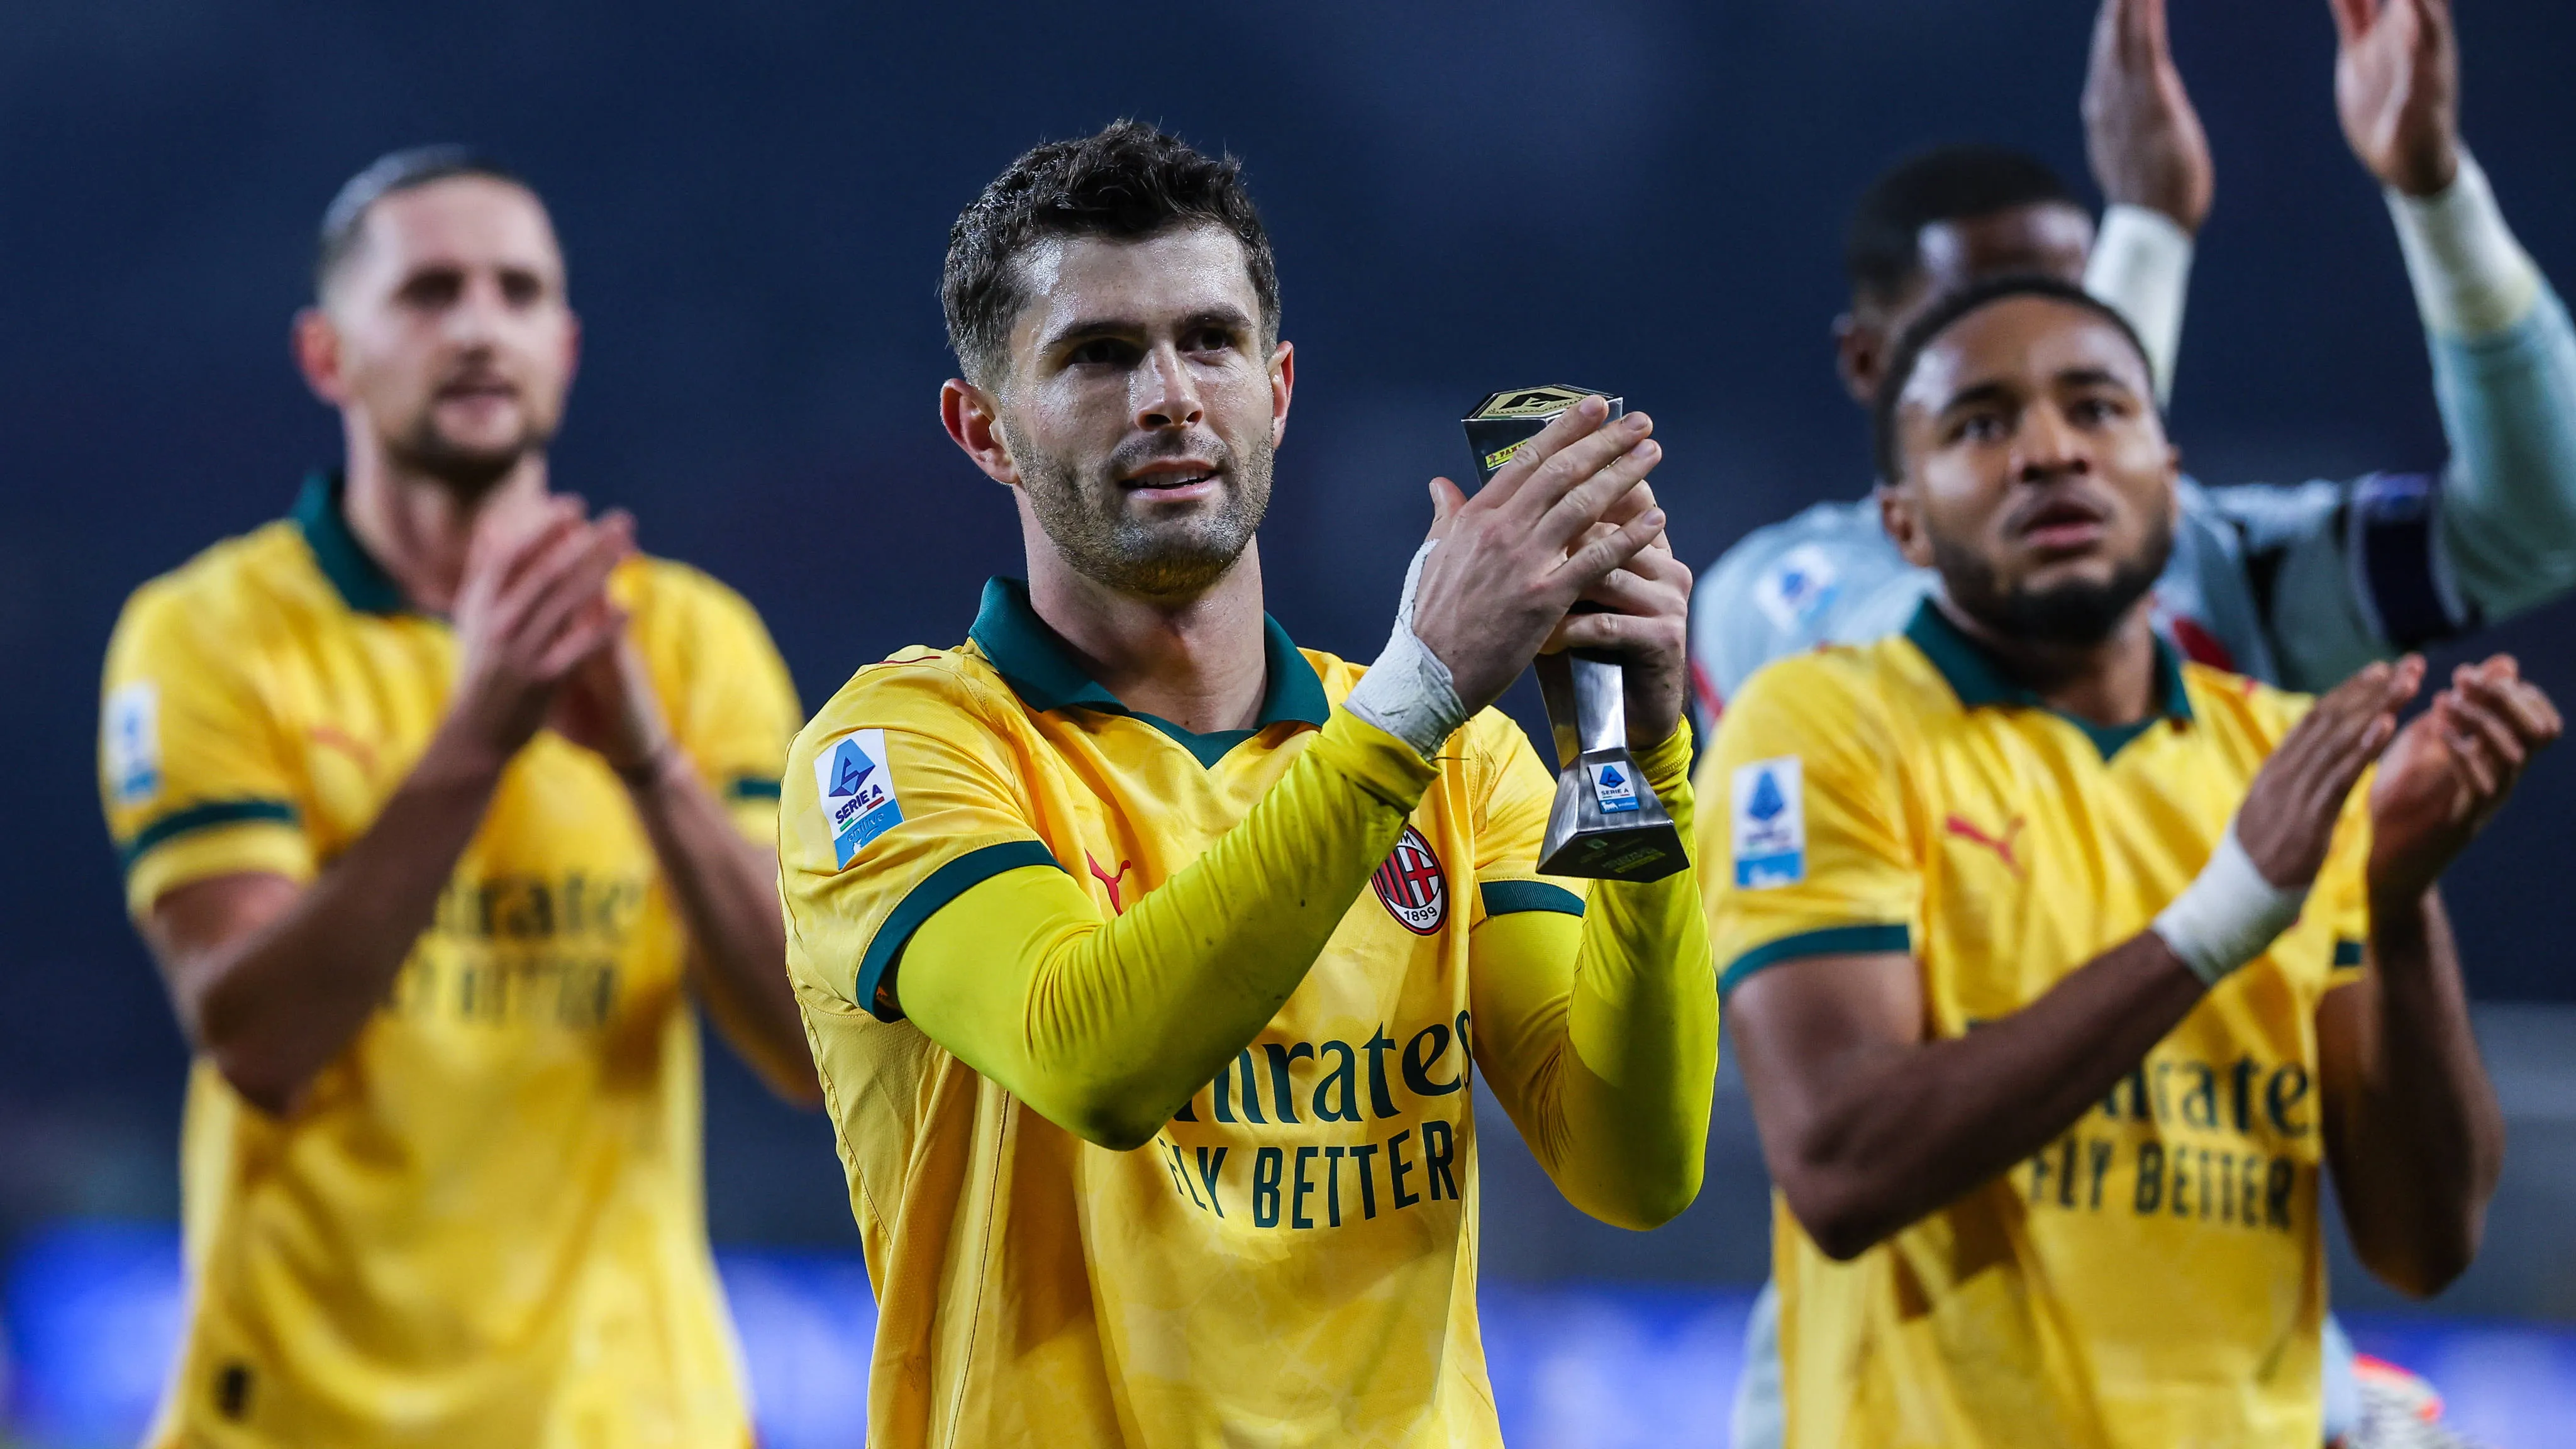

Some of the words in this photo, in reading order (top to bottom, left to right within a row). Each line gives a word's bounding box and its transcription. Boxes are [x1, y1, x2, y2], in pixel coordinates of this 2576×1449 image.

[835, 790, 870, 824] SERIE
[872, 784, 883, 798] A
[847, 813, 884, 841] enilive
[1404, 906, 1438, 922] 1899
[1174, 1009, 1472, 1124] irates
[1157, 1136, 1229, 1218] FLY
[1252, 1120, 1459, 1230] BETTER
